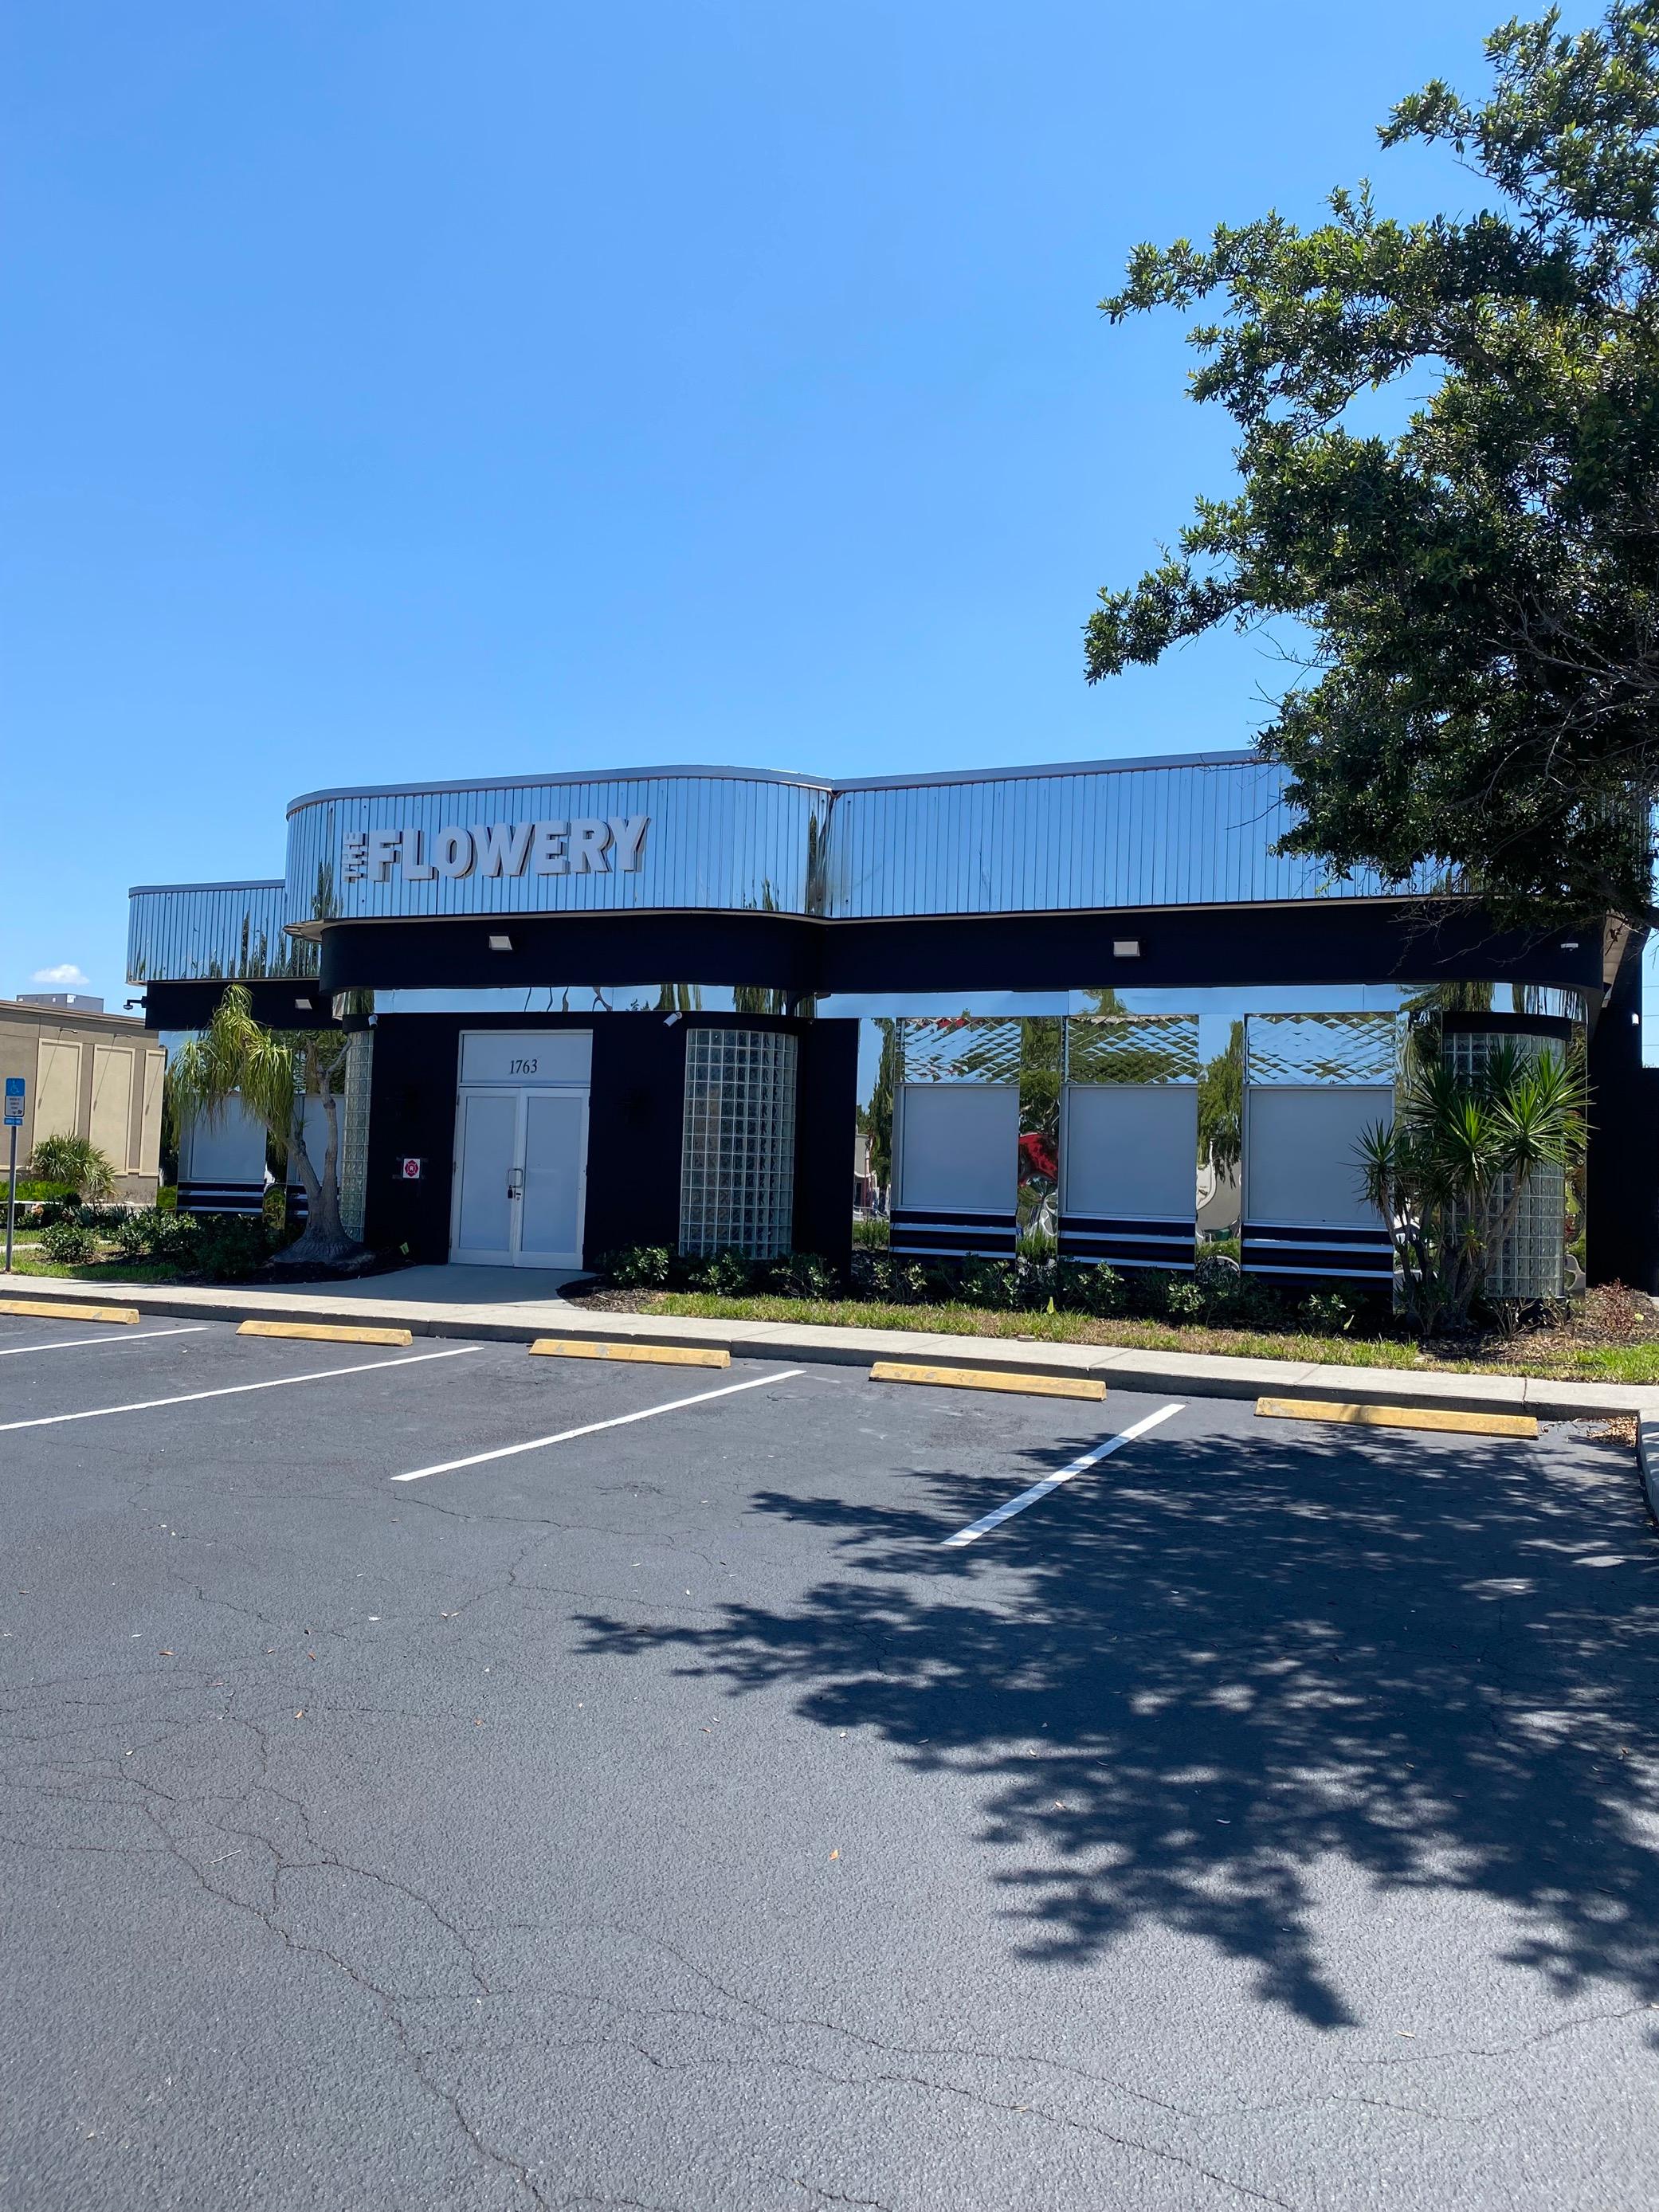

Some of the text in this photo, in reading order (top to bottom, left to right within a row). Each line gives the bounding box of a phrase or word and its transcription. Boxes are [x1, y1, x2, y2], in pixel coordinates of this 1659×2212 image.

[342, 815, 650, 882] THE FLOWERY
[510, 1059, 538, 1074] 1763
